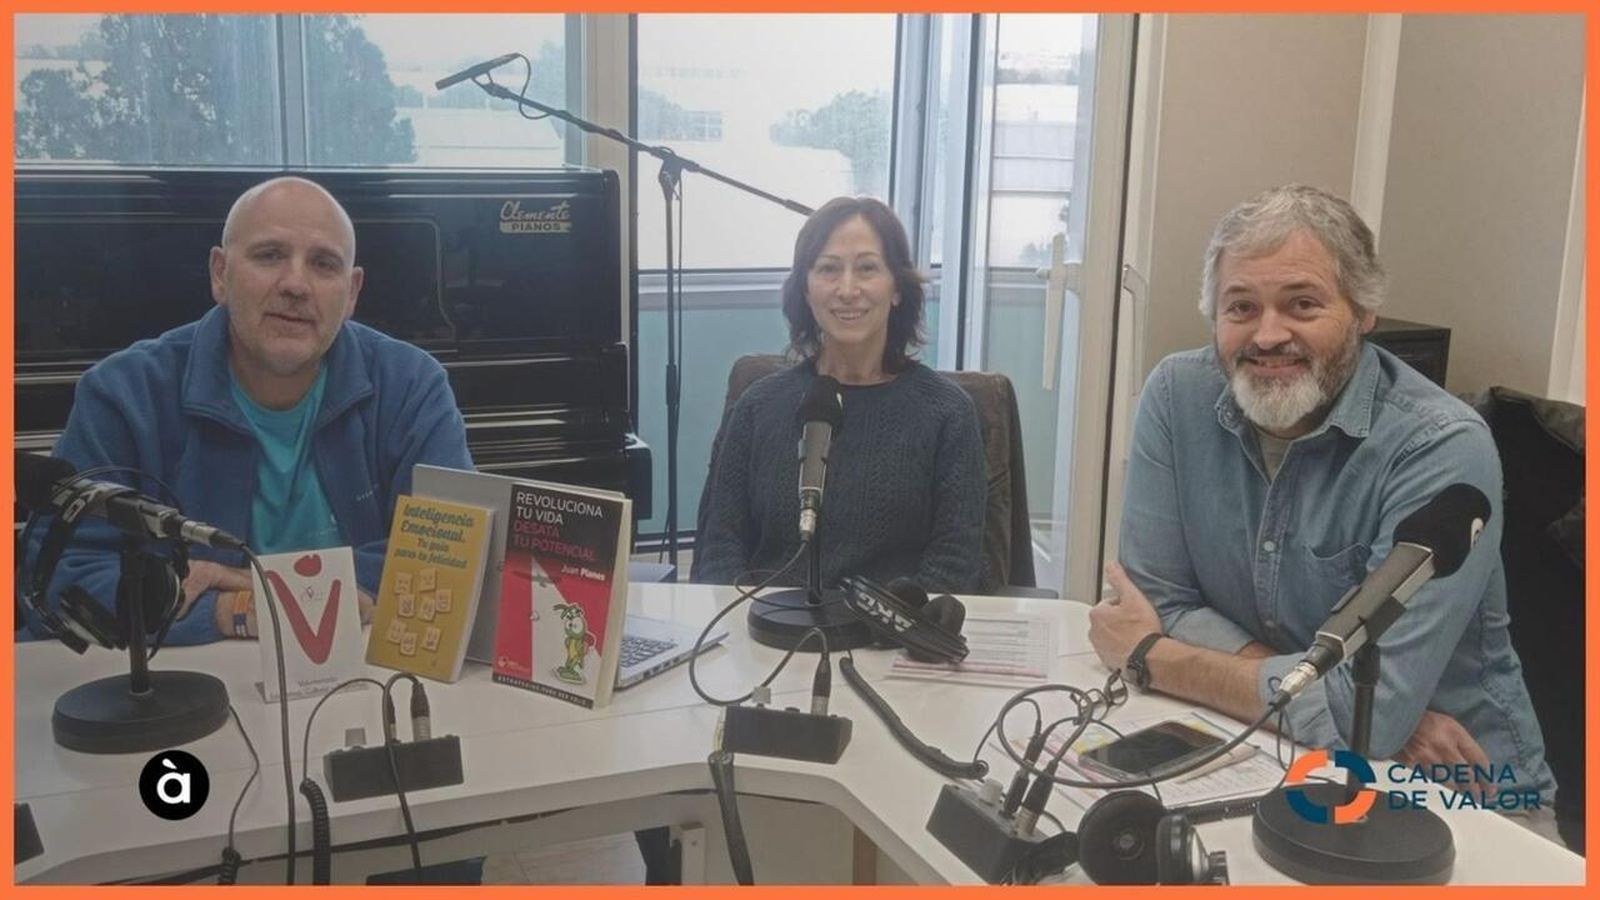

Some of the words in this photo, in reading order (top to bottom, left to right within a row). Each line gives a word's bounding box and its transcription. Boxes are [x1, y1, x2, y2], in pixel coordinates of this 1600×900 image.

[500, 201, 571, 221] Clemente
[511, 222, 561, 232] PIANOS
[516, 491, 603, 518] REVOLUCIONA
[403, 504, 475, 527] Inteligencia
[516, 506, 532, 519] TU
[535, 509, 564, 525] VIDA
[401, 520, 466, 543] Emocional.
[514, 521, 561, 538] DESATA
[513, 534, 530, 547] TU
[531, 538, 596, 561] POTENCIAL
[428, 550, 469, 570] felicidad
[561, 564, 580, 575] Juan
[855, 595, 916, 633] AKG
